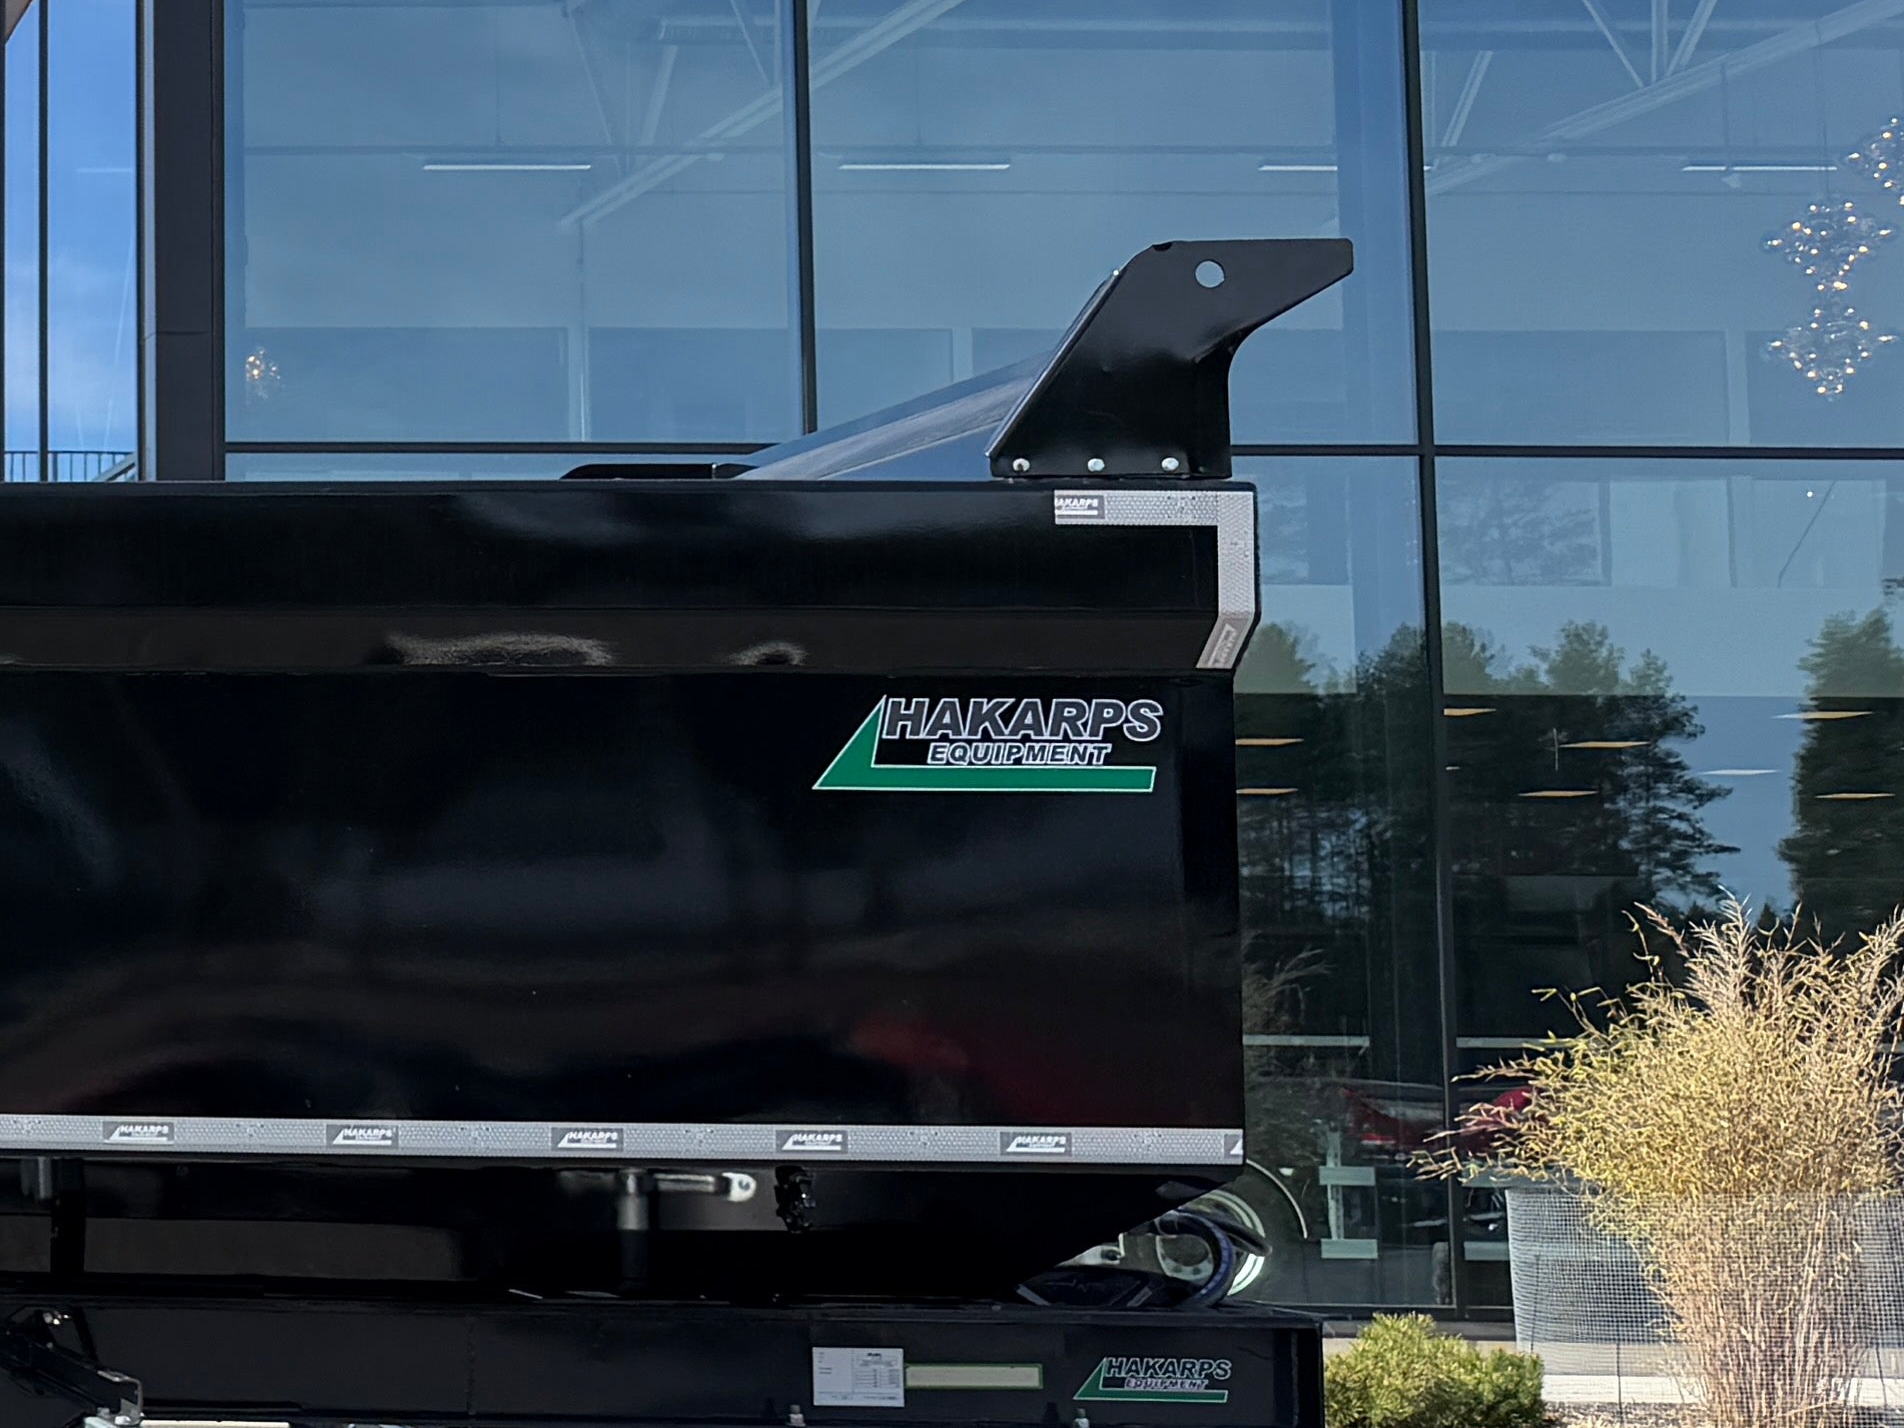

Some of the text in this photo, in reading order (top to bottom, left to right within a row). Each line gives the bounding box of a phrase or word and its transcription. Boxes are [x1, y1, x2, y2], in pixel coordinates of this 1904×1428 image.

[882, 698, 1163, 741] HAKARPS
[927, 742, 1112, 765] EQUIPMENT
[1105, 1357, 1232, 1379] HAKARPS
